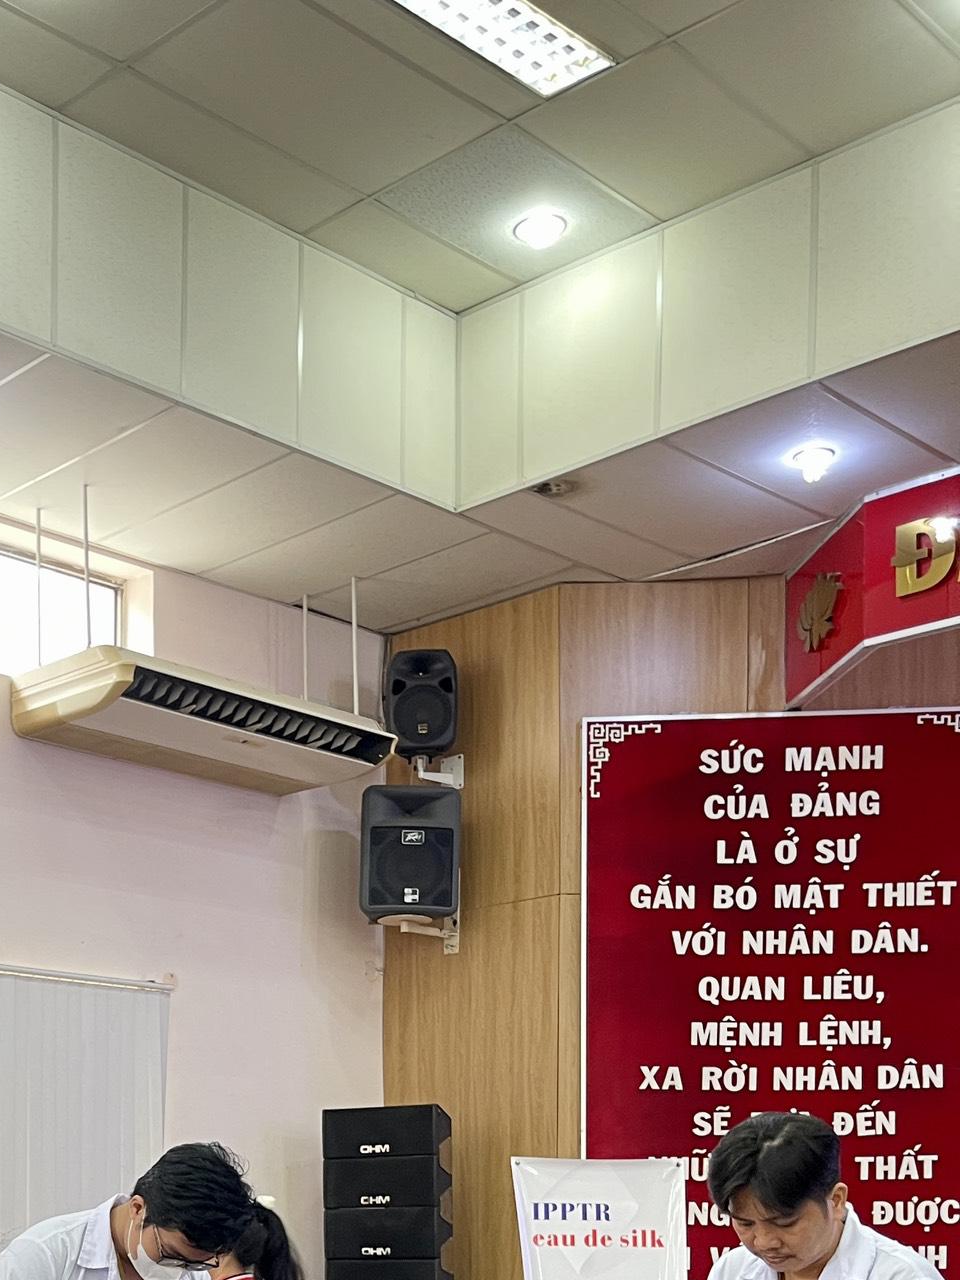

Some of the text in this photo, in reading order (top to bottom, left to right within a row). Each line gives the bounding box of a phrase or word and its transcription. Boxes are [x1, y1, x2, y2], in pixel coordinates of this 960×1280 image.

[699, 740, 883, 777] SỨC MẠNH
[704, 782, 879, 819] CỦA ĐẢNG
[717, 827, 860, 870] LÀ Ở SỰ
[630, 870, 957, 914] GẮN BÓ MẬT THIẾT
[672, 922, 928, 955] VỚI NHÂN DÂN.
[699, 969, 884, 1005] QUAN LIÊU,
[691, 1015, 891, 1052] MỆNH LỆNH,
[639, 1058, 943, 1091] XA RỜI NHÂN DÂN
[693, 1100, 895, 1136] SẼ ĐẾN
[360, 1144, 389, 1154] OHM
[855, 1144, 938, 1180] THẤT
[532, 1202, 611, 1221] IPPTR
[871, 1196, 960, 1232] ĐƯỢC
[361, 1247, 391, 1256] OHM
[532, 1228, 665, 1248] eau de silk
